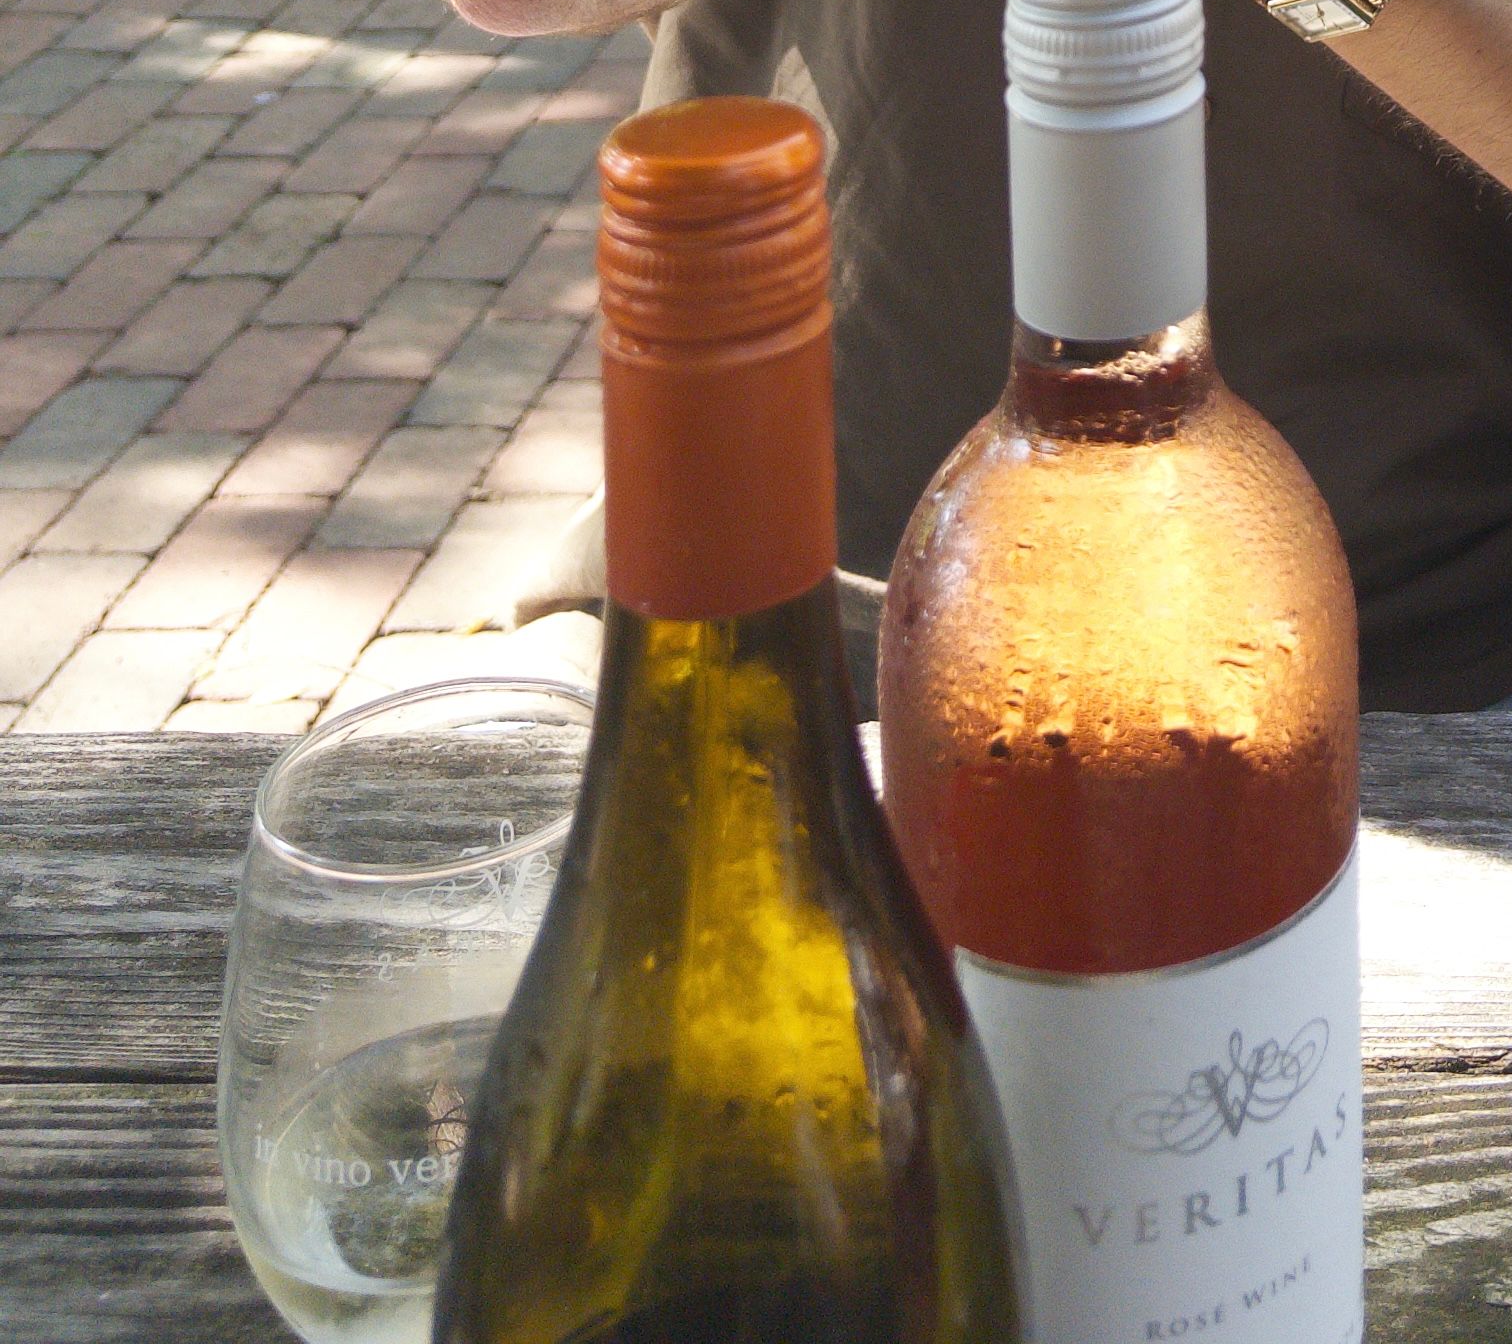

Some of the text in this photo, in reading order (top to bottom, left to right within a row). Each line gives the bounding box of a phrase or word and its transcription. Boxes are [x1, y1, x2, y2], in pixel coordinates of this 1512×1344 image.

[254, 1120, 462, 1188] in vino ver
[1073, 1091, 1348, 1246] VERITAS
[1241, 1252, 1312, 1311] WINE
